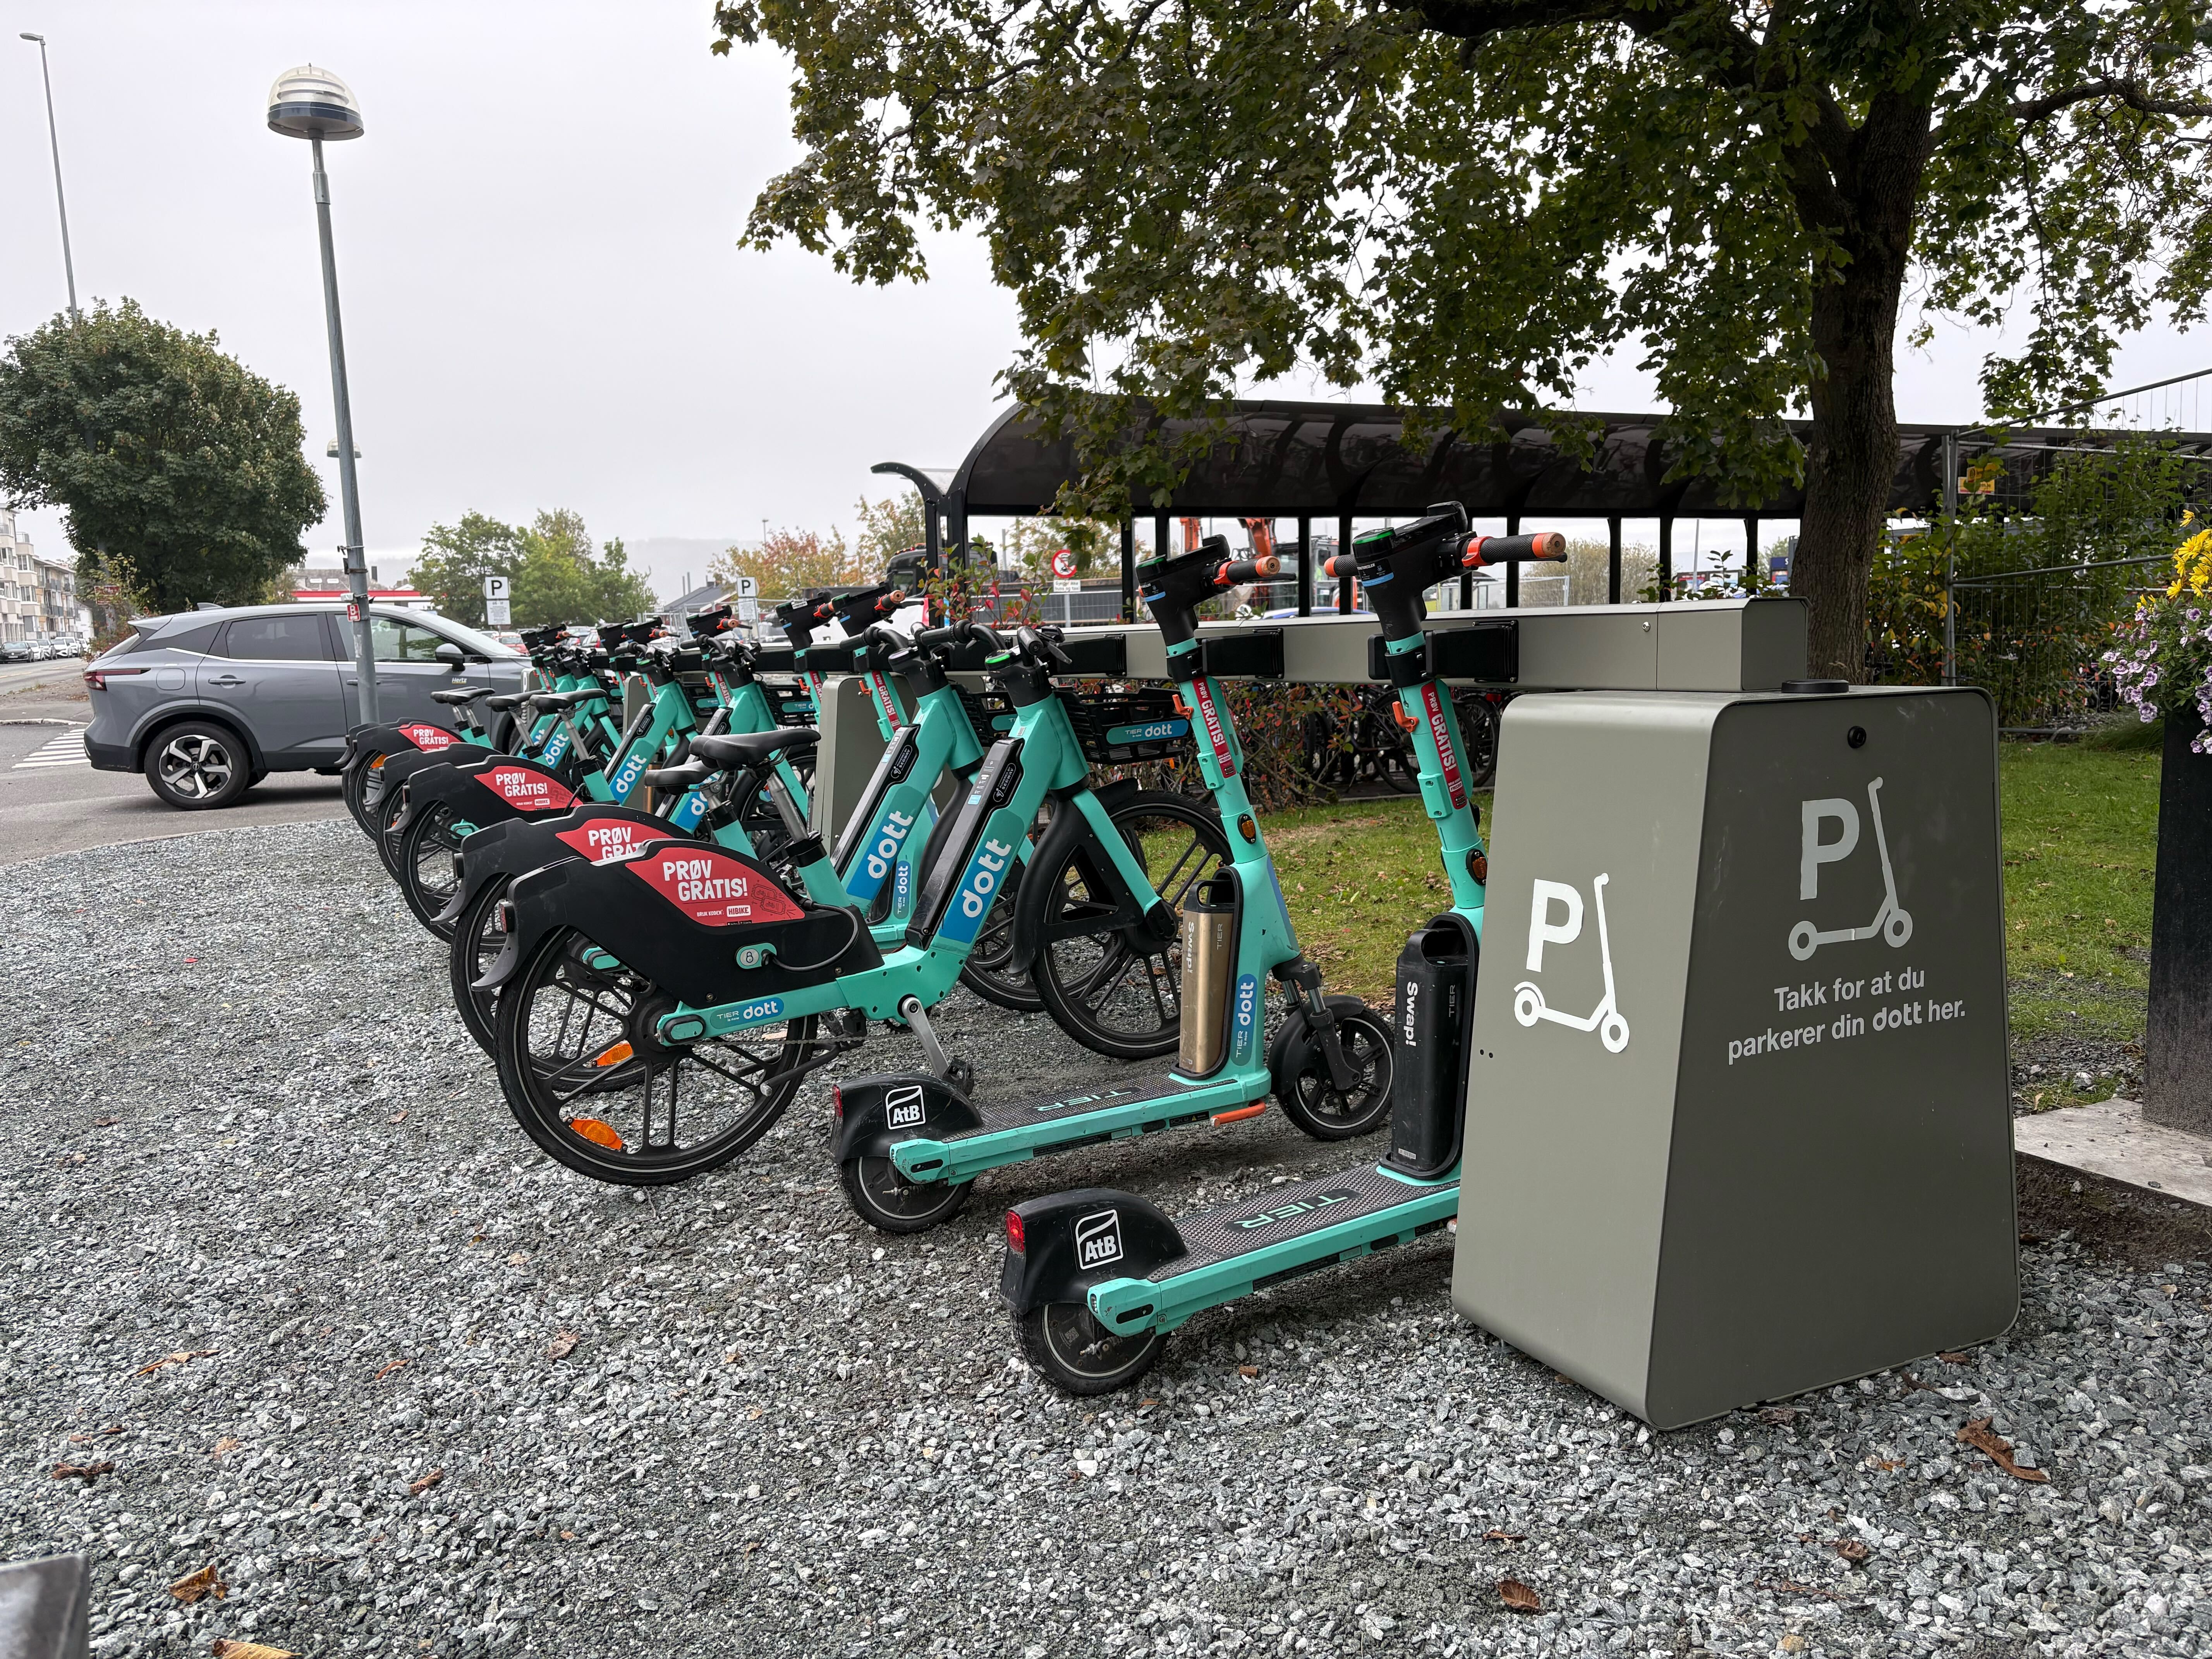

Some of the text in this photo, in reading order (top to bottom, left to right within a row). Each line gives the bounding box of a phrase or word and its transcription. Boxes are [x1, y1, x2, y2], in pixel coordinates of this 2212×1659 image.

[491, 580, 502, 596] P
[742, 580, 750, 594] P
[350, 605, 356, 615] B
[878, 685, 896, 716] GRATIS!
[1197, 682, 1209, 699] PRØV
[1427, 692, 1439, 712] PRØV
[413, 729, 434, 737] PRØV
[1145, 724, 1172, 737] dott
[1201, 699, 1226, 747] GRATIS!
[419, 736, 449, 745] GRATIS!
[545, 733, 569, 766] dott
[1431, 713, 1457, 772] GRATIS!
[496, 772, 526, 786] PRØV
[617, 754, 647, 793] dott
[505, 782, 548, 797] GRATIS!
[588, 826, 632, 846] PRØV
[867, 810, 914, 879] dott
[1800, 798, 1860, 900] P
[663, 859, 712, 881] PRØV
[898, 866, 908, 894] dott
[962, 838, 1012, 918] dott
[678, 877, 748, 902] GRATIS!
[728, 907, 749, 915] HIBIKE
[1526, 878, 1584, 972] P
[1774, 966, 1925, 1012] Takk for at du
[716, 1010, 739, 1020] TIER
[743, 1001, 778, 1019] dott
[1238, 982, 1254, 1026] dott
[1405, 981, 1418, 1047] Swap!
[1728, 999, 1965, 1065] parkerer din dott her.
[1033, 1090, 1132, 1111] TIER
[893, 1104, 920, 1123] AtB
[1234, 1195, 1348, 1229] TIER
[1085, 1237, 1117, 1263] AtB
